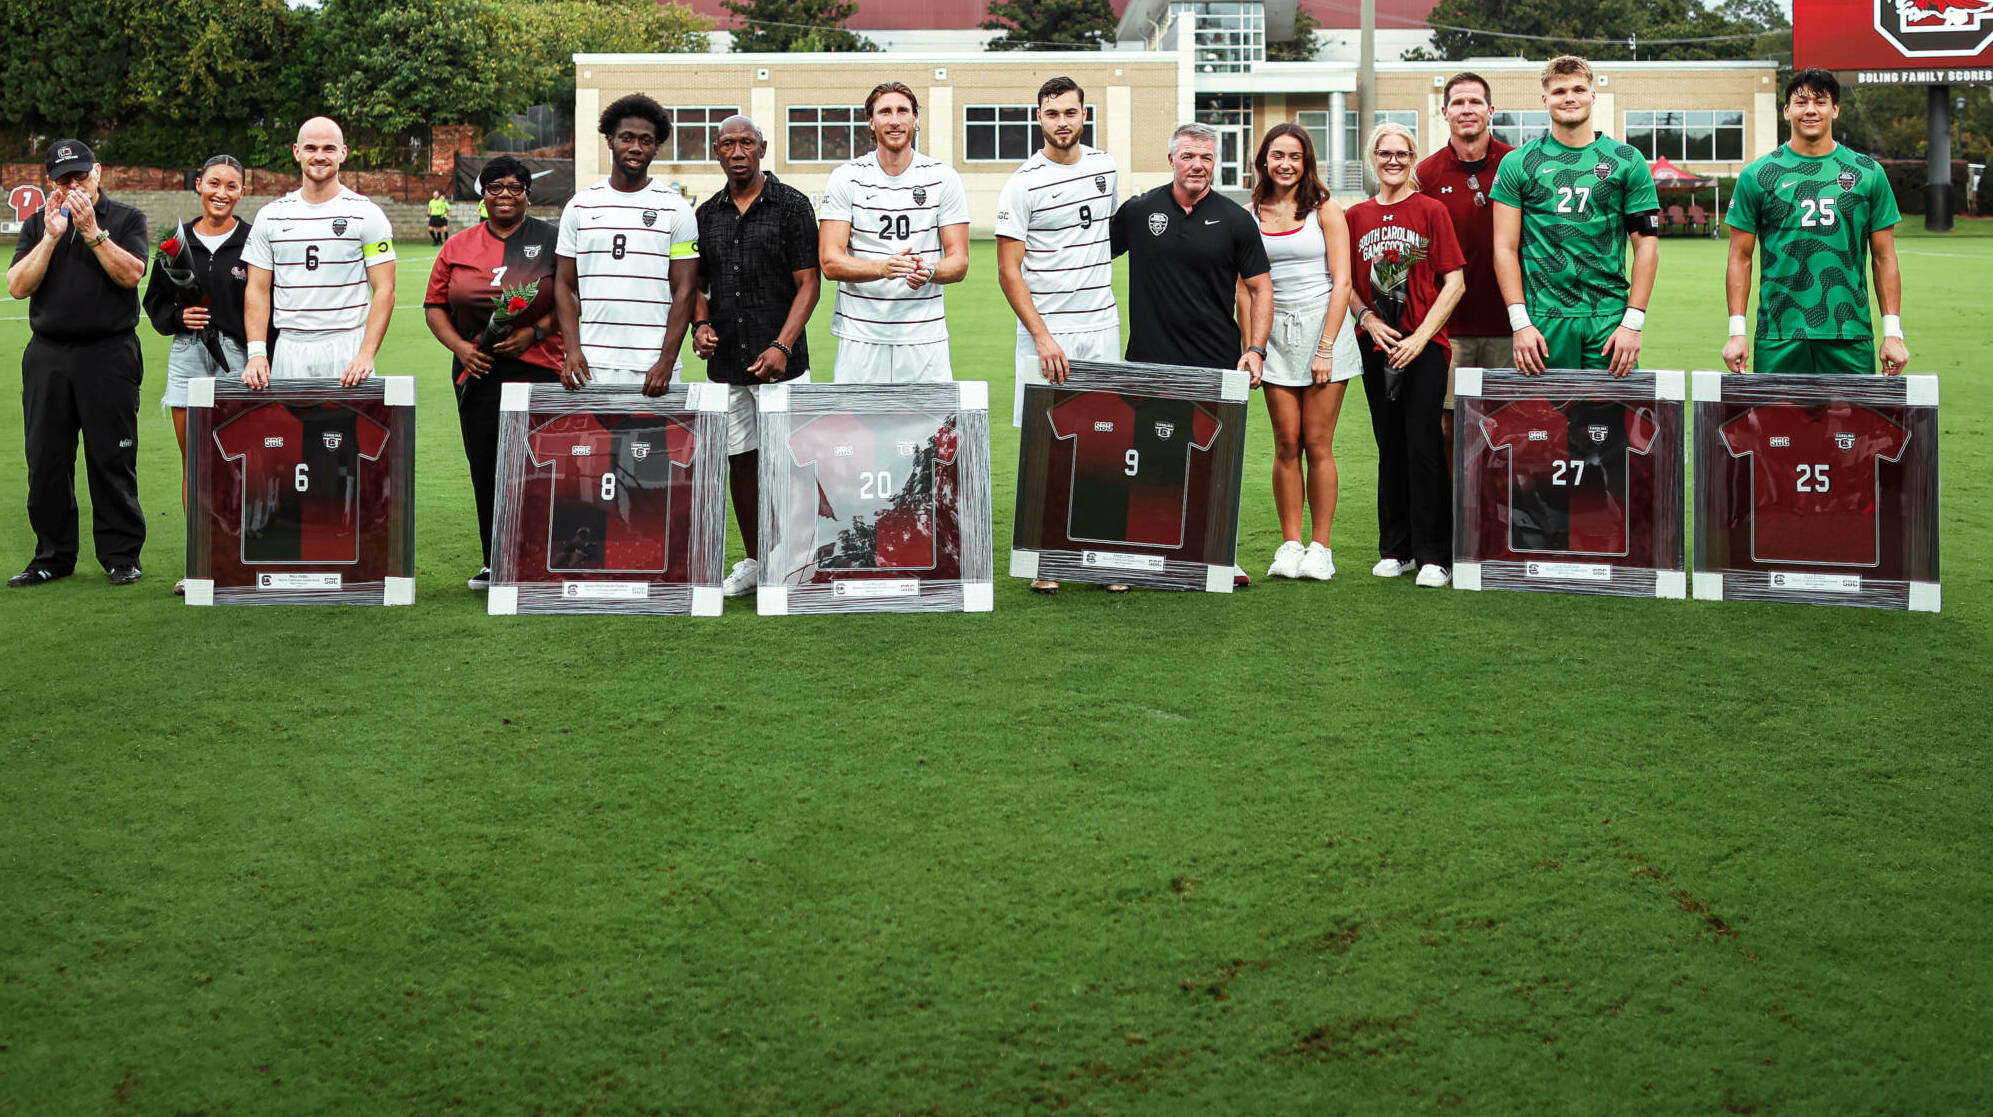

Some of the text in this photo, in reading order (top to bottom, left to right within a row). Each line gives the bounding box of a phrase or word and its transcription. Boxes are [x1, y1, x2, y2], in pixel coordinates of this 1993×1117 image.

[1858, 72, 1899, 83] BOLING
[1901, 71, 1944, 82] FAMILY
[23, 191, 32, 207] 7
[1557, 186, 1590, 213] 27
[1079, 205, 1093, 230] 9
[1800, 198, 1836, 227] 25
[879, 214, 910, 241] 20
[1381, 225, 1420, 249] CAROLINA
[305, 245, 319, 271] 6
[612, 234, 626, 260] 8
[490, 265, 508, 287] 7
[1124, 449, 1139, 477] 9
[1552, 460, 1585, 486] 27
[295, 463, 309, 492] 6
[601, 472, 616, 501] 8
[859, 471, 892, 500] 20
[1796, 464, 1830, 493] 25
